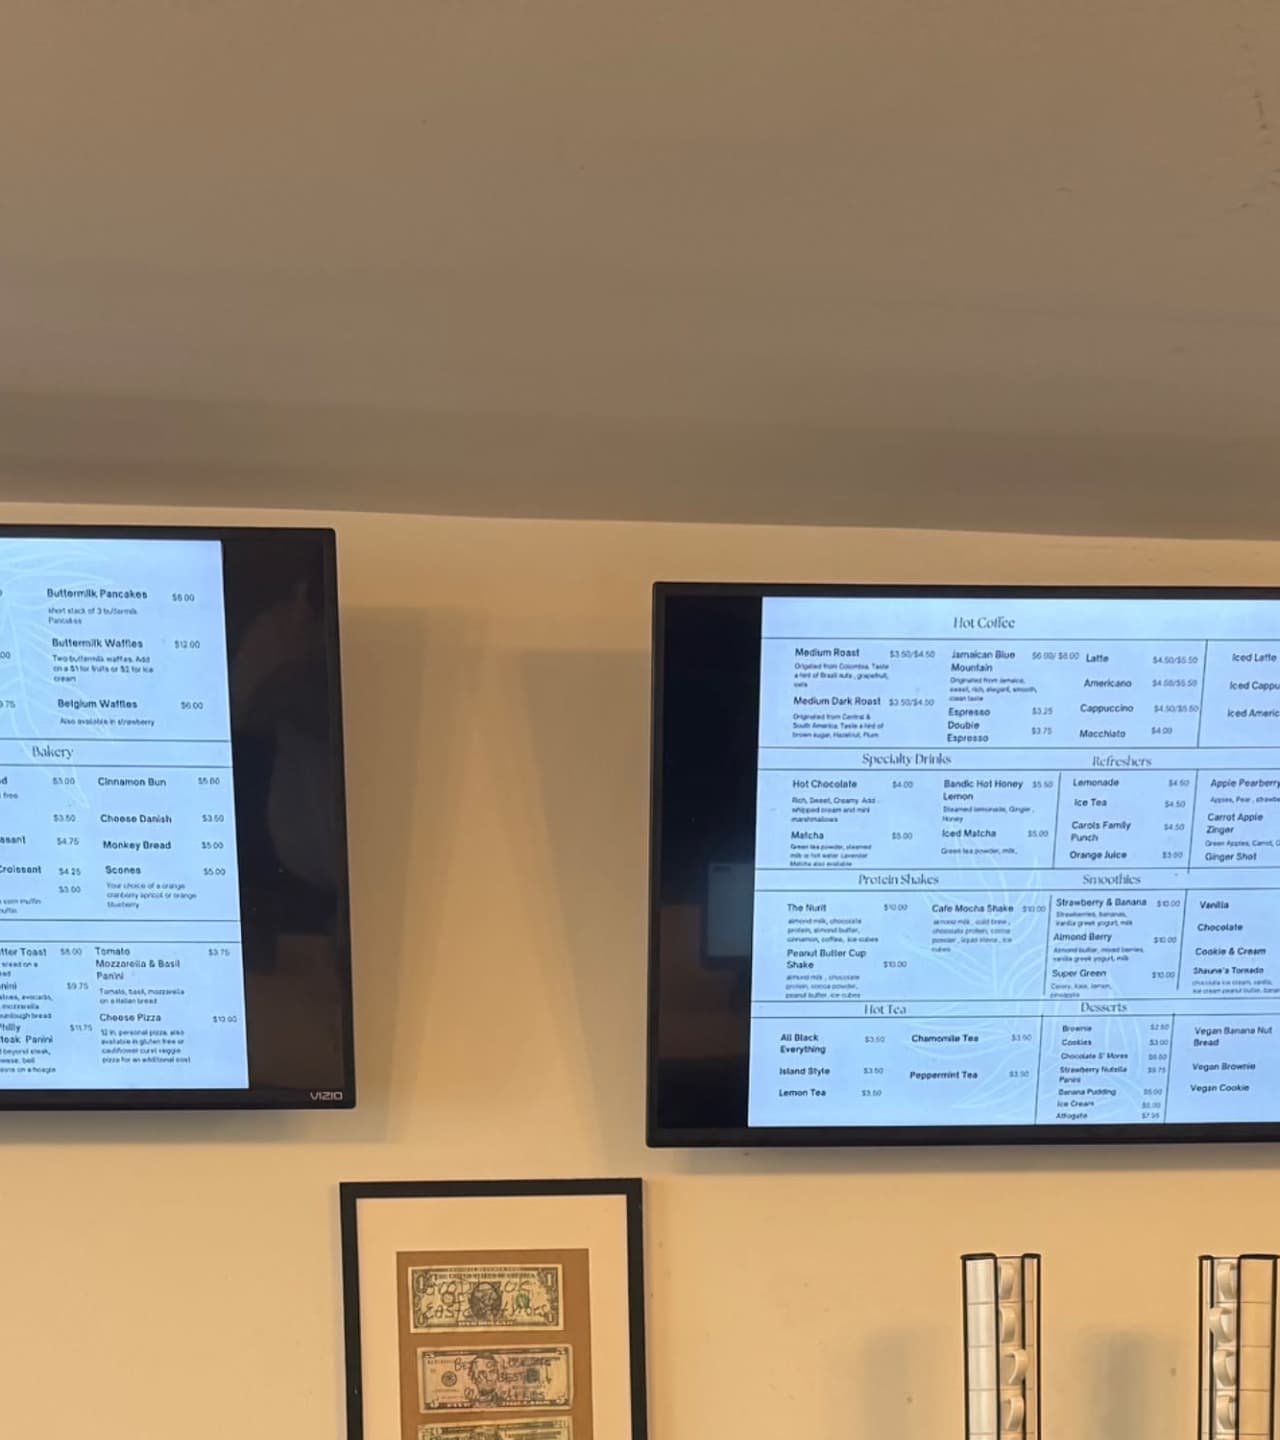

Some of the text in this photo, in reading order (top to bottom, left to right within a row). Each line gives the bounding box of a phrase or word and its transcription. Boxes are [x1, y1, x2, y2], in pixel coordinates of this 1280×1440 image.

[46, 588, 148, 600] Buttermilk Pancakes
[953, 616, 1016, 629] Hot Coffee
[51, 637, 143, 649] Buttermilk Waffles
[1085, 653, 1109, 663] Latte
[1083, 678, 1132, 689] Americano
[793, 696, 881, 706] Medium Dark Roast
[1079, 703, 1134, 715] Cappuccino
[32, 745, 74, 761] Bakery
[862, 752, 952, 767] Specialty Drinks
[1092, 755, 1152, 767] Refreshers
[792, 779, 857, 789] Hot Chocolate
[1072, 777, 1119, 788] Lemonade
[858, 873, 939, 887] Protein Shakes
[1082, 873, 1141, 886] Smoothies
[1199, 899, 1229, 910] Vanilla
[1197, 921, 1243, 933] Chocolate
[1053, 932, 1112, 944] Almond Berry
[864, 1003, 907, 1016] Hot Tea
[1080, 1000, 1128, 1014] Desserts
[1192, 1061, 1256, 1074] Vegan Brownie
[309, 1091, 343, 1101] VIZIO
[778, 1087, 826, 1098] Lemon Tea
